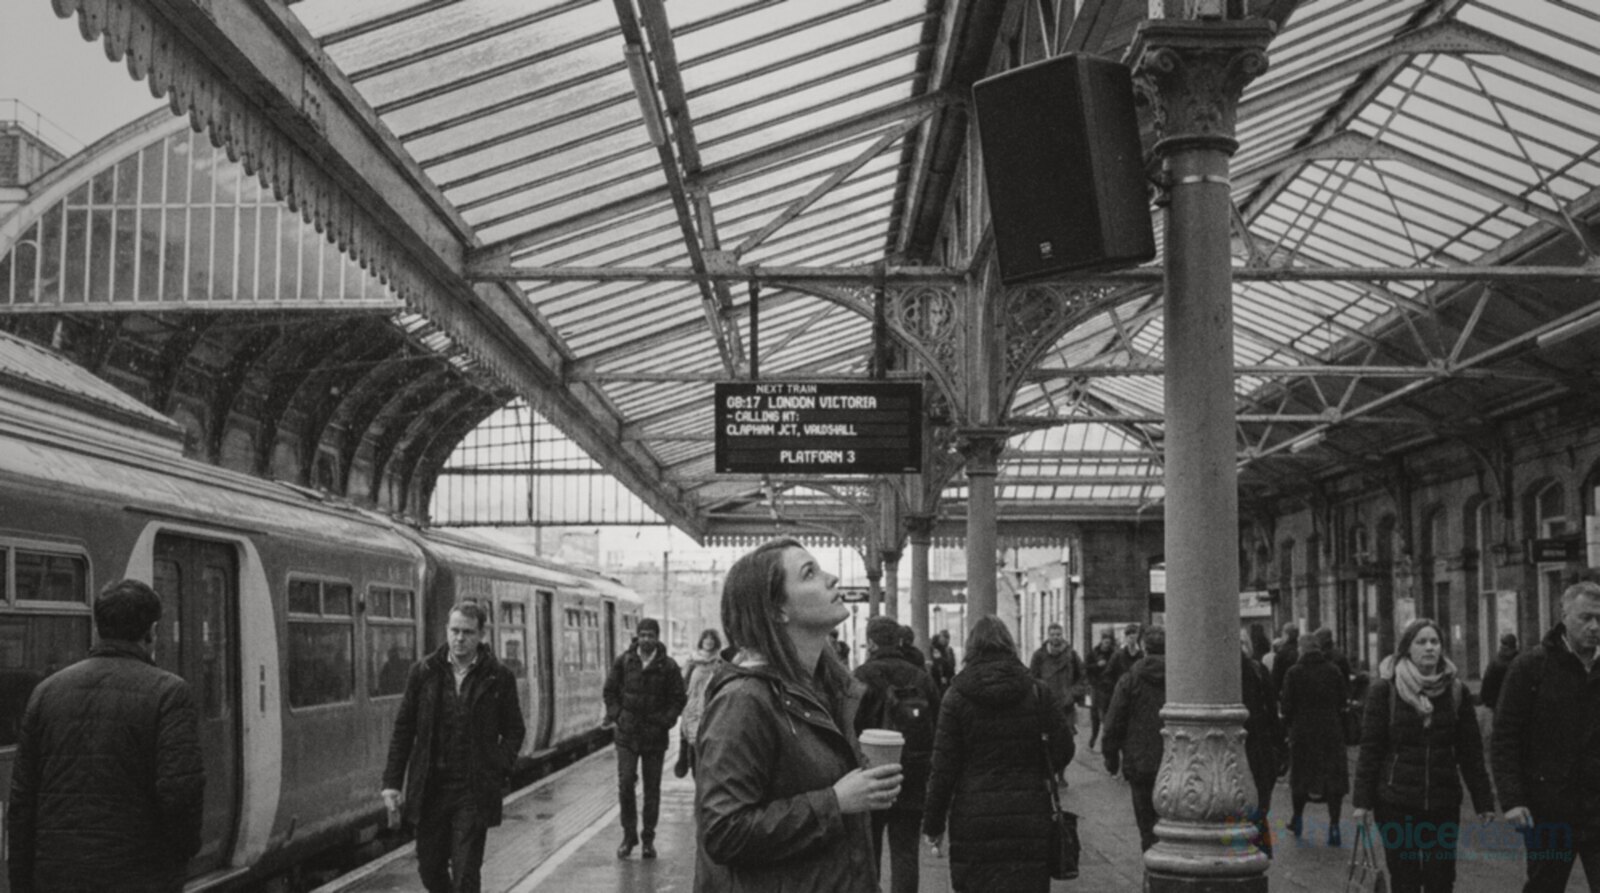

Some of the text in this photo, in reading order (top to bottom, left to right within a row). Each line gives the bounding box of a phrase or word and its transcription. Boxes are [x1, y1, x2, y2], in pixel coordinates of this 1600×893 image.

[756, 384, 817, 394] NEXT TRAIN
[726, 396, 877, 409] 08:17 LONDON VICTORIA
[735, 410, 780, 422] CALLING
[782, 410, 800, 422] AT:
[726, 424, 775, 436] CLAPHAM
[777, 424, 801, 437] JCT,
[780, 450, 856, 463] PLATFORM 3
